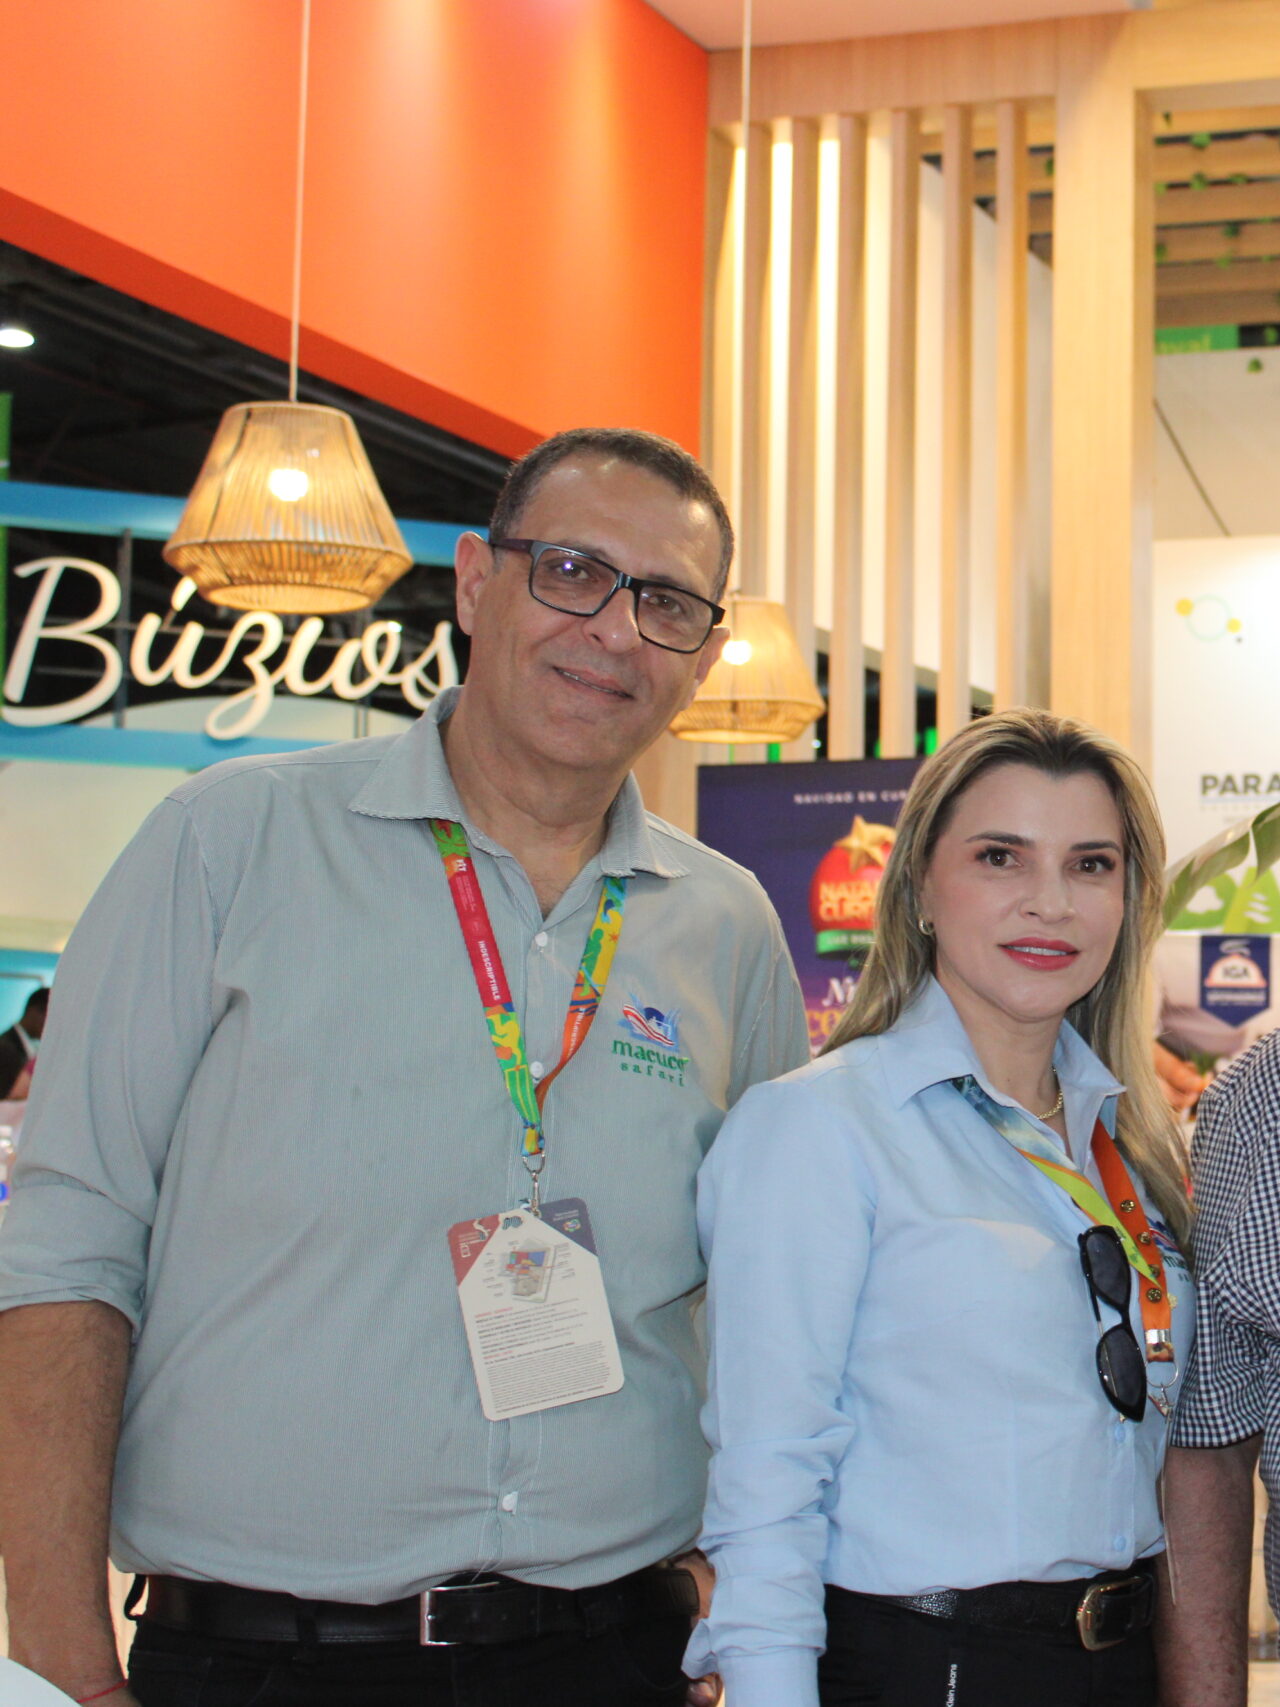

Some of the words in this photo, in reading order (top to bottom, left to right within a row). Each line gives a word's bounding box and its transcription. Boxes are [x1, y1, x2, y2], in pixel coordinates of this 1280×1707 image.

[0, 556, 458, 740] Búzios
[612, 1040, 685, 1072] macuco
[620, 1062, 685, 1087] safari
[947, 1663, 958, 1689] Jeans
